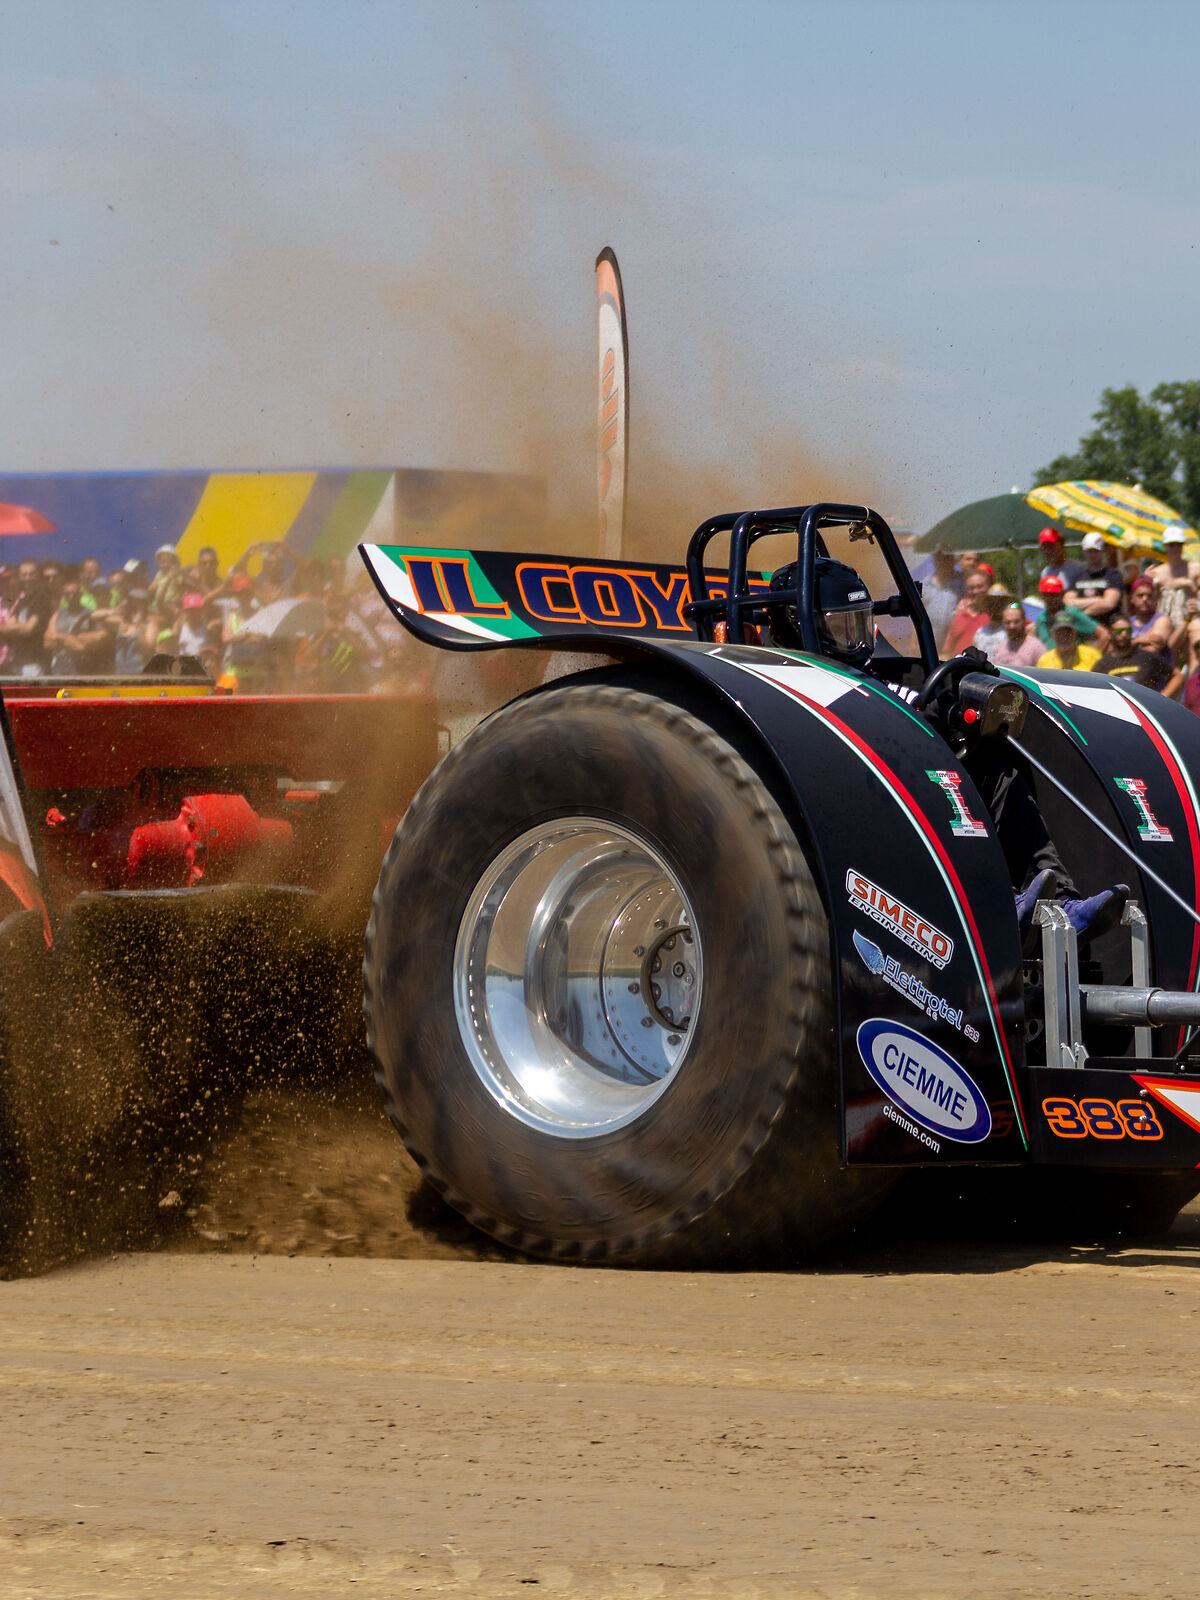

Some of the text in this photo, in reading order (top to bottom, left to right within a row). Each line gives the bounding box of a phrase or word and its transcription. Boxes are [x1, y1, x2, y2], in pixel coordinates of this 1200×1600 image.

[398, 554, 770, 634] IL COY
[850, 896, 946, 969] ENGINEERING
[853, 877, 948, 957] SIMECO
[884, 956, 963, 1030] Elettrotel
[883, 1044, 967, 1122] CIEMME
[1042, 1097, 1163, 1141] 388
[883, 1104, 941, 1153] ciemme.com
